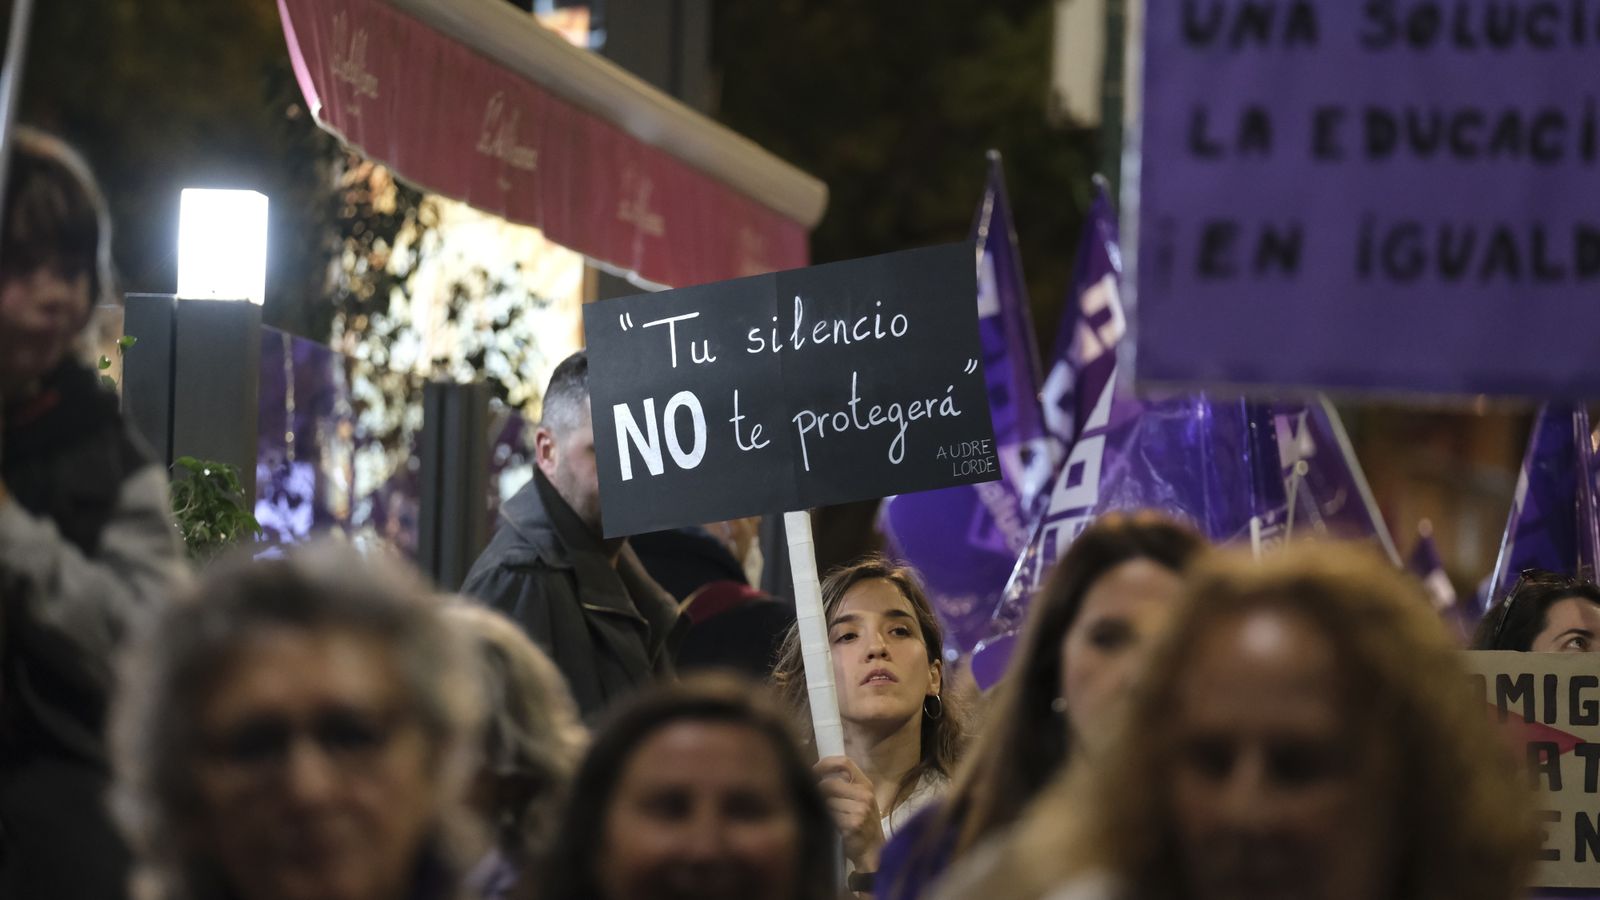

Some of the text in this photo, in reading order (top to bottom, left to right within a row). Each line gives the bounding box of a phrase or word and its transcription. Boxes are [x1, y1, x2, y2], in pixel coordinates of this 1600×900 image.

[1180, 0, 1600, 51] UNA SOLUCI
[1188, 104, 1273, 159] LA
[746, 295, 908, 354] silencio
[612, 390, 708, 482] NO
[728, 388, 771, 452] te
[936, 438, 993, 460] AUDRE
[951, 455, 997, 477] LORDE
